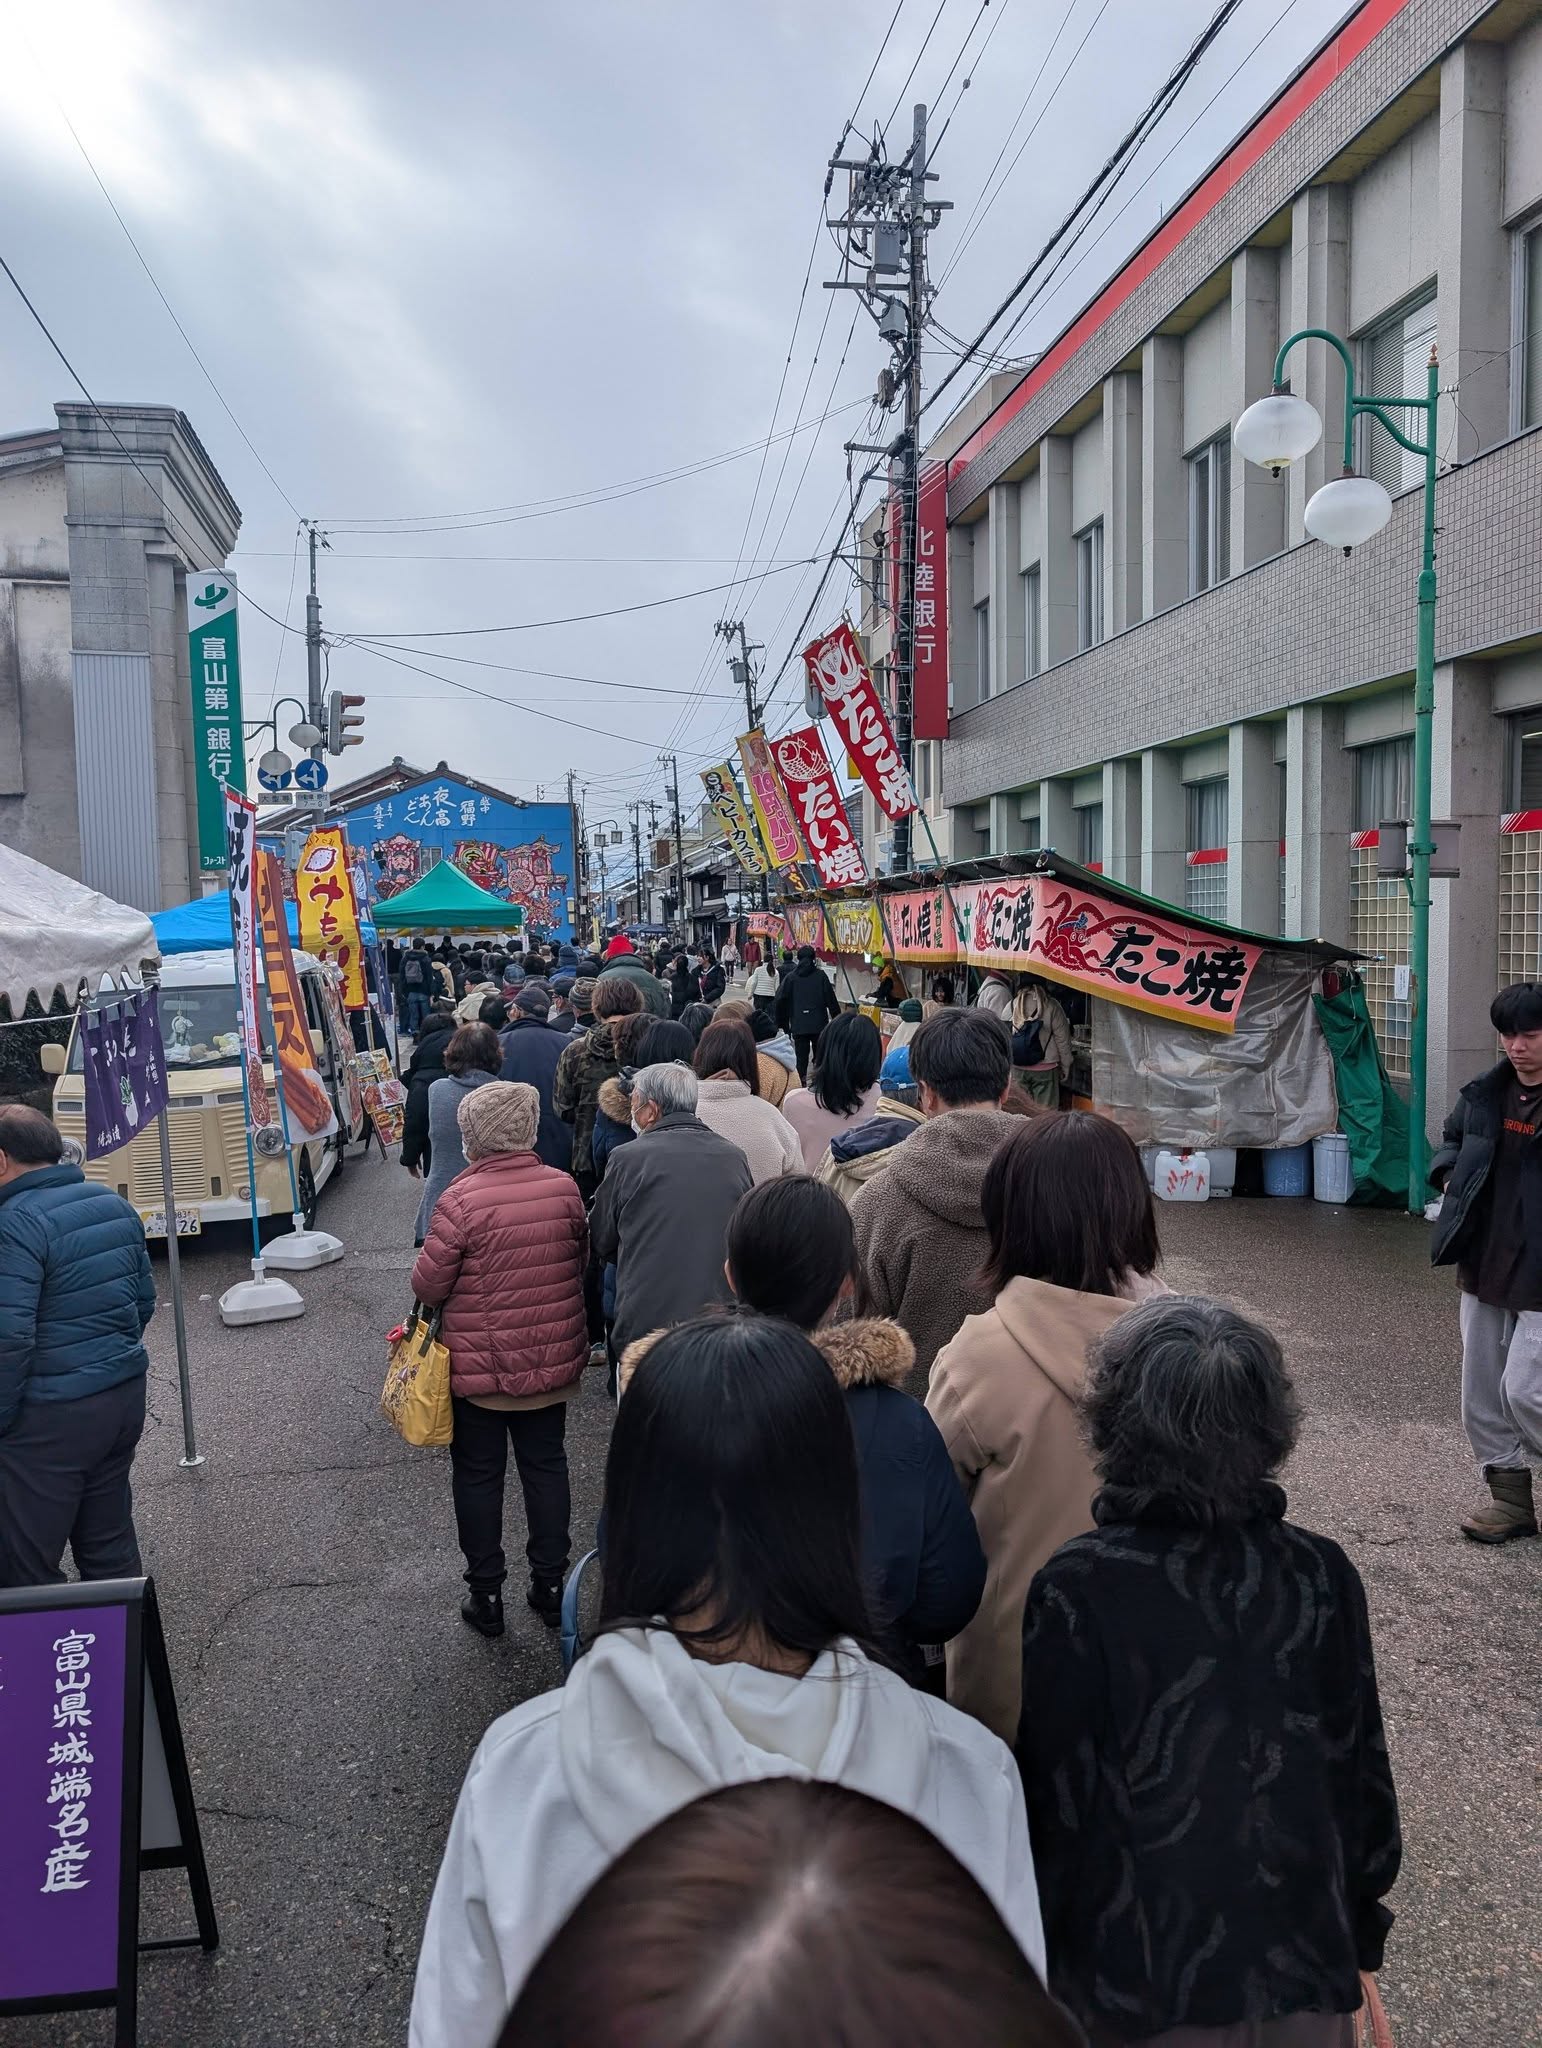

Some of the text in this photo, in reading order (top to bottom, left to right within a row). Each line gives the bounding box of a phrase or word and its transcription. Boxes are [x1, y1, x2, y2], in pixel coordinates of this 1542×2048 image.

[201, 637, 232, 776] 富山第一銀行
[839, 690, 917, 814] たこ焼
[204, 856, 226, 866] ファースト
[714, 791, 763, 874] ベビーカステラ
[799, 780, 864, 884] たい焼
[901, 900, 931, 948] たい焼
[991, 884, 1034, 951] たこ焼
[1100, 925, 1248, 1013] たこ焼
[40, 1629, 96, 1894] 富山県城端名産
